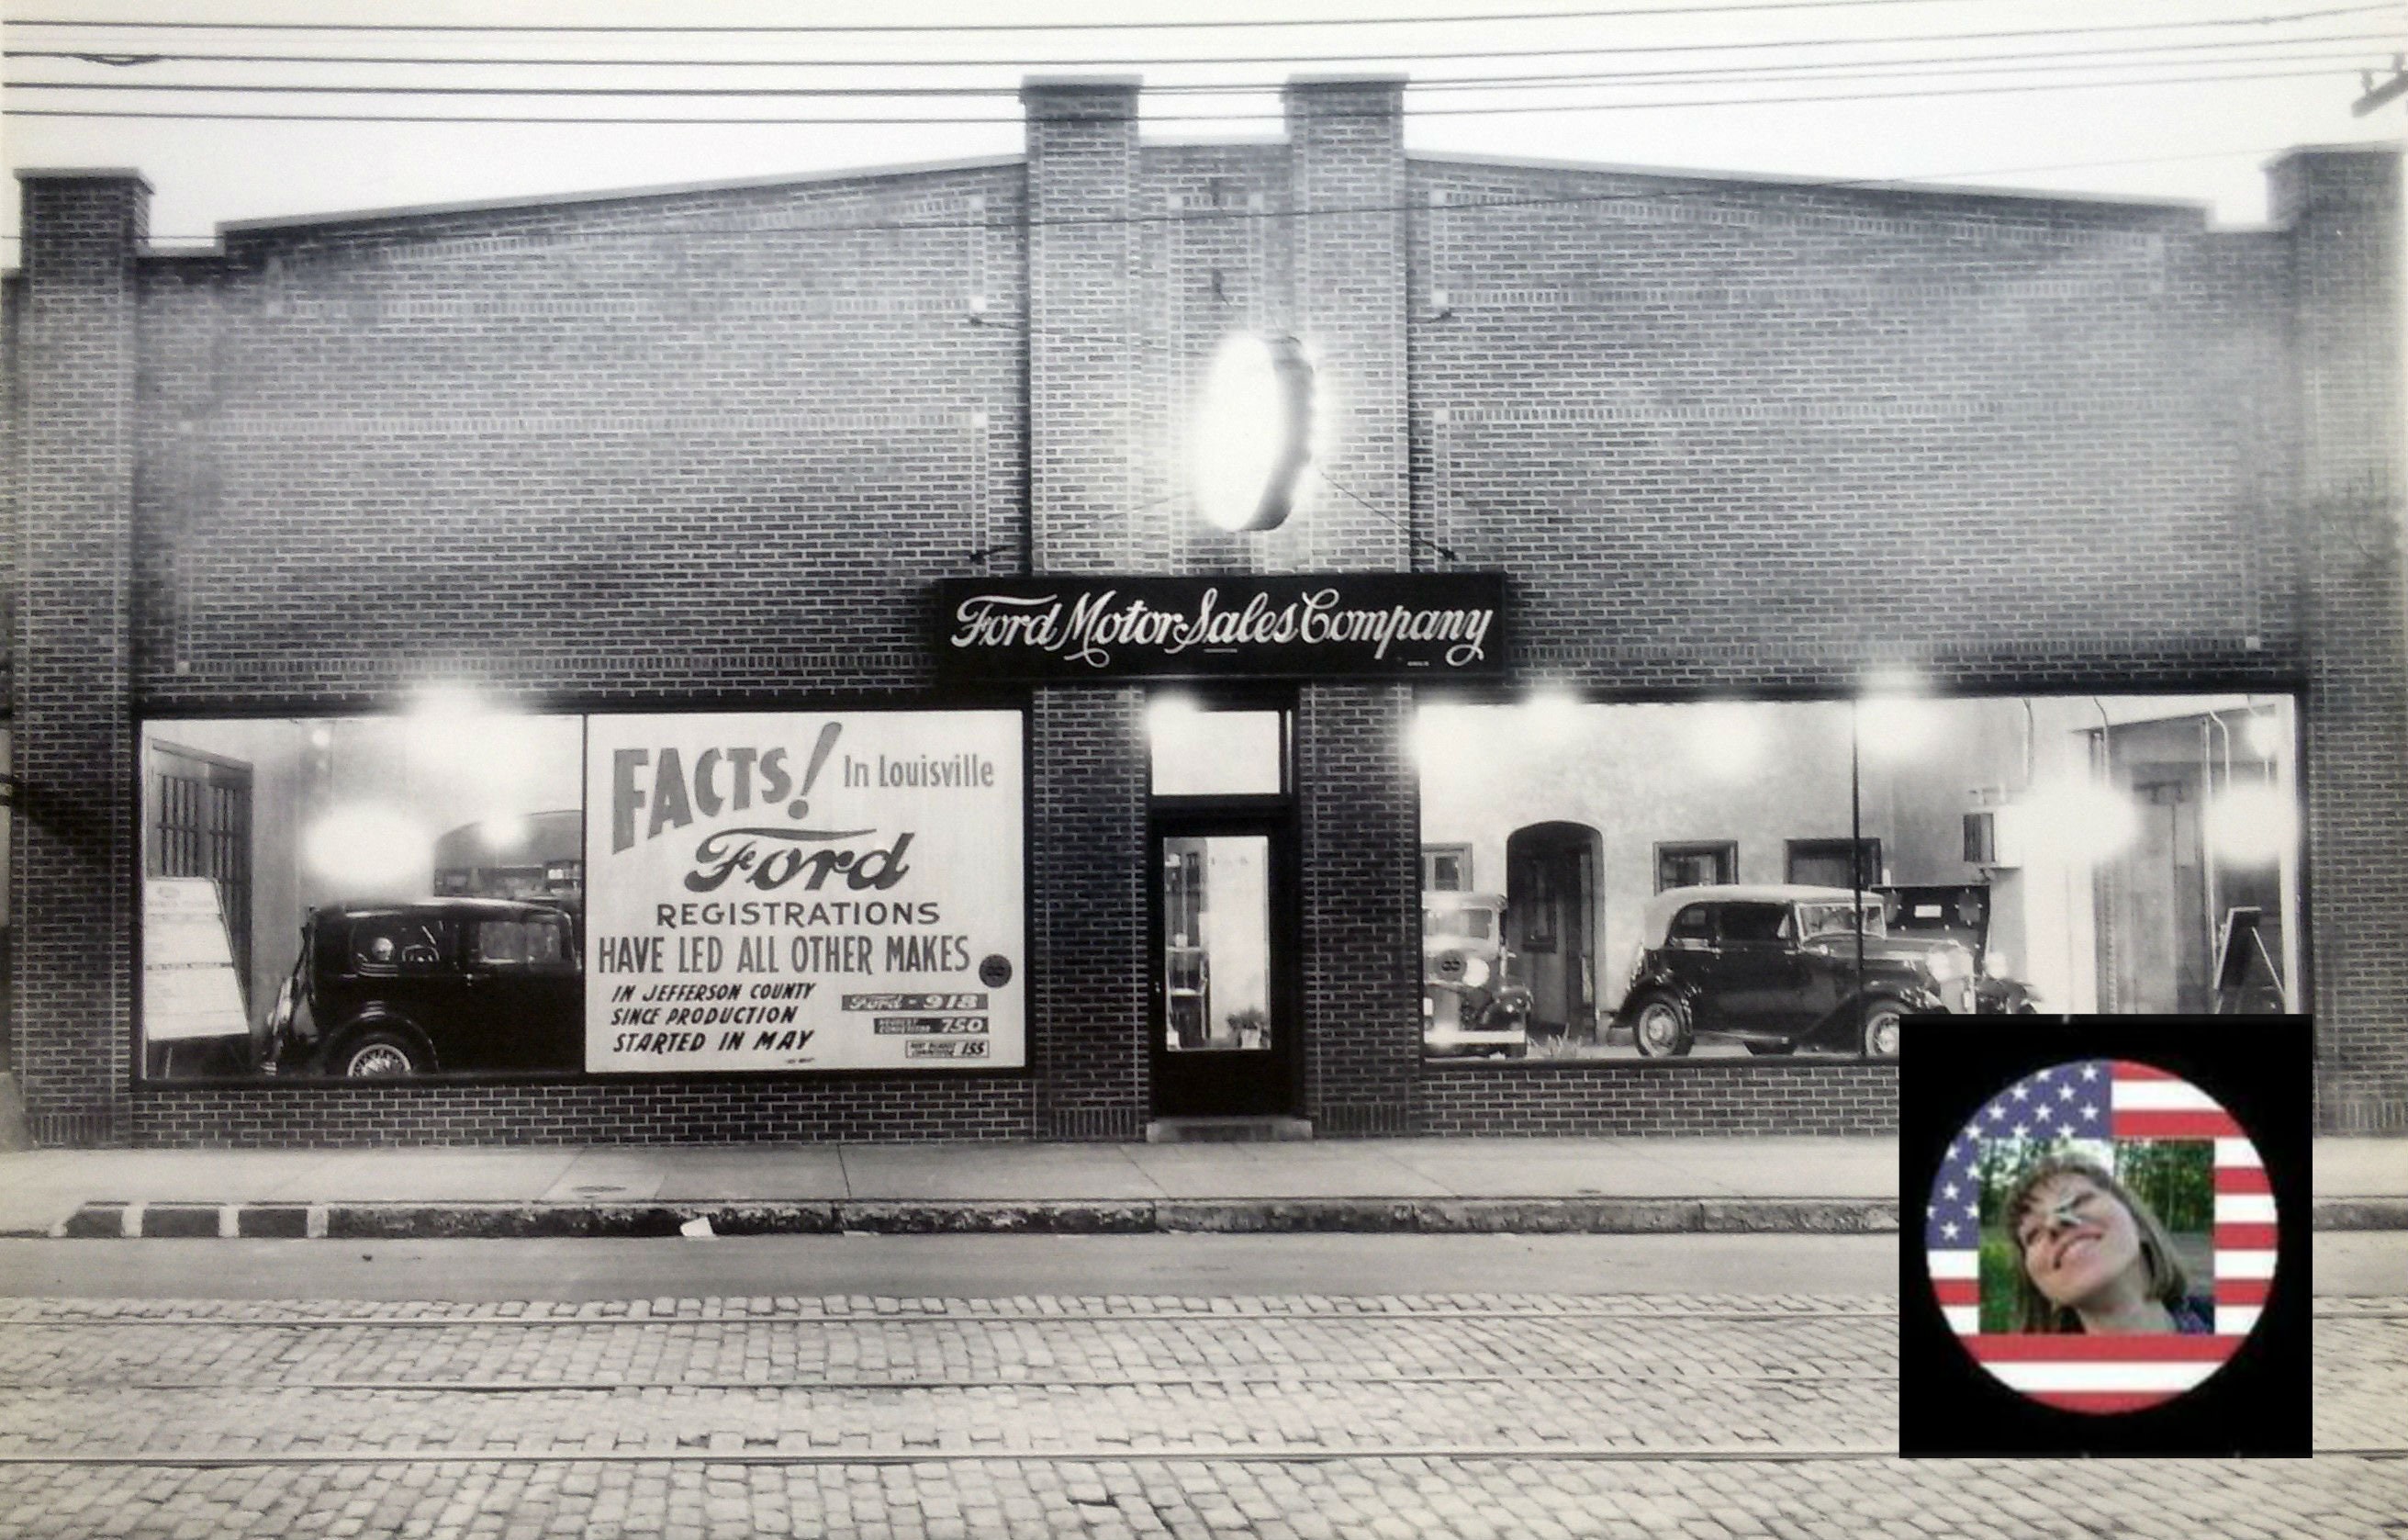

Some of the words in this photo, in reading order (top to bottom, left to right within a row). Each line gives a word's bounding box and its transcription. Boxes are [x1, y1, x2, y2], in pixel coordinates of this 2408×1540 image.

[950, 594, 1062, 647] Ford
[1045, 590, 1184, 668] Motor
[1164, 588, 1299, 654] Sales
[1300, 589, 1494, 667] Company
[844, 755, 869, 788] In
[879, 754, 994, 788] Louisville
[612, 722, 843, 855] FACTS!
[684, 826, 915, 893] Ford
[656, 902, 941, 928] REGISTRATIONS
[599, 936, 666, 974] HAVE
[678, 936, 723, 973] LED
[736, 935, 779, 973] ALL
[790, 935, 873, 975] OTHER
[885, 935, 970, 973] MAKES
[611, 984, 636, 1003] IN
[643, 984, 743, 1003] JEFFERSON
[750, 982, 817, 1000] COUNTY
[923, 994, 979, 1009] 918
[610, 1007, 661, 1026] SINCE
[665, 1006, 799, 1025] PRODUCTION
[941, 1018, 983, 1033] 750
[613, 1032, 706, 1055] STARTED
[718, 1030, 745, 1051] IN
[752, 1029, 815, 1051] MAY
